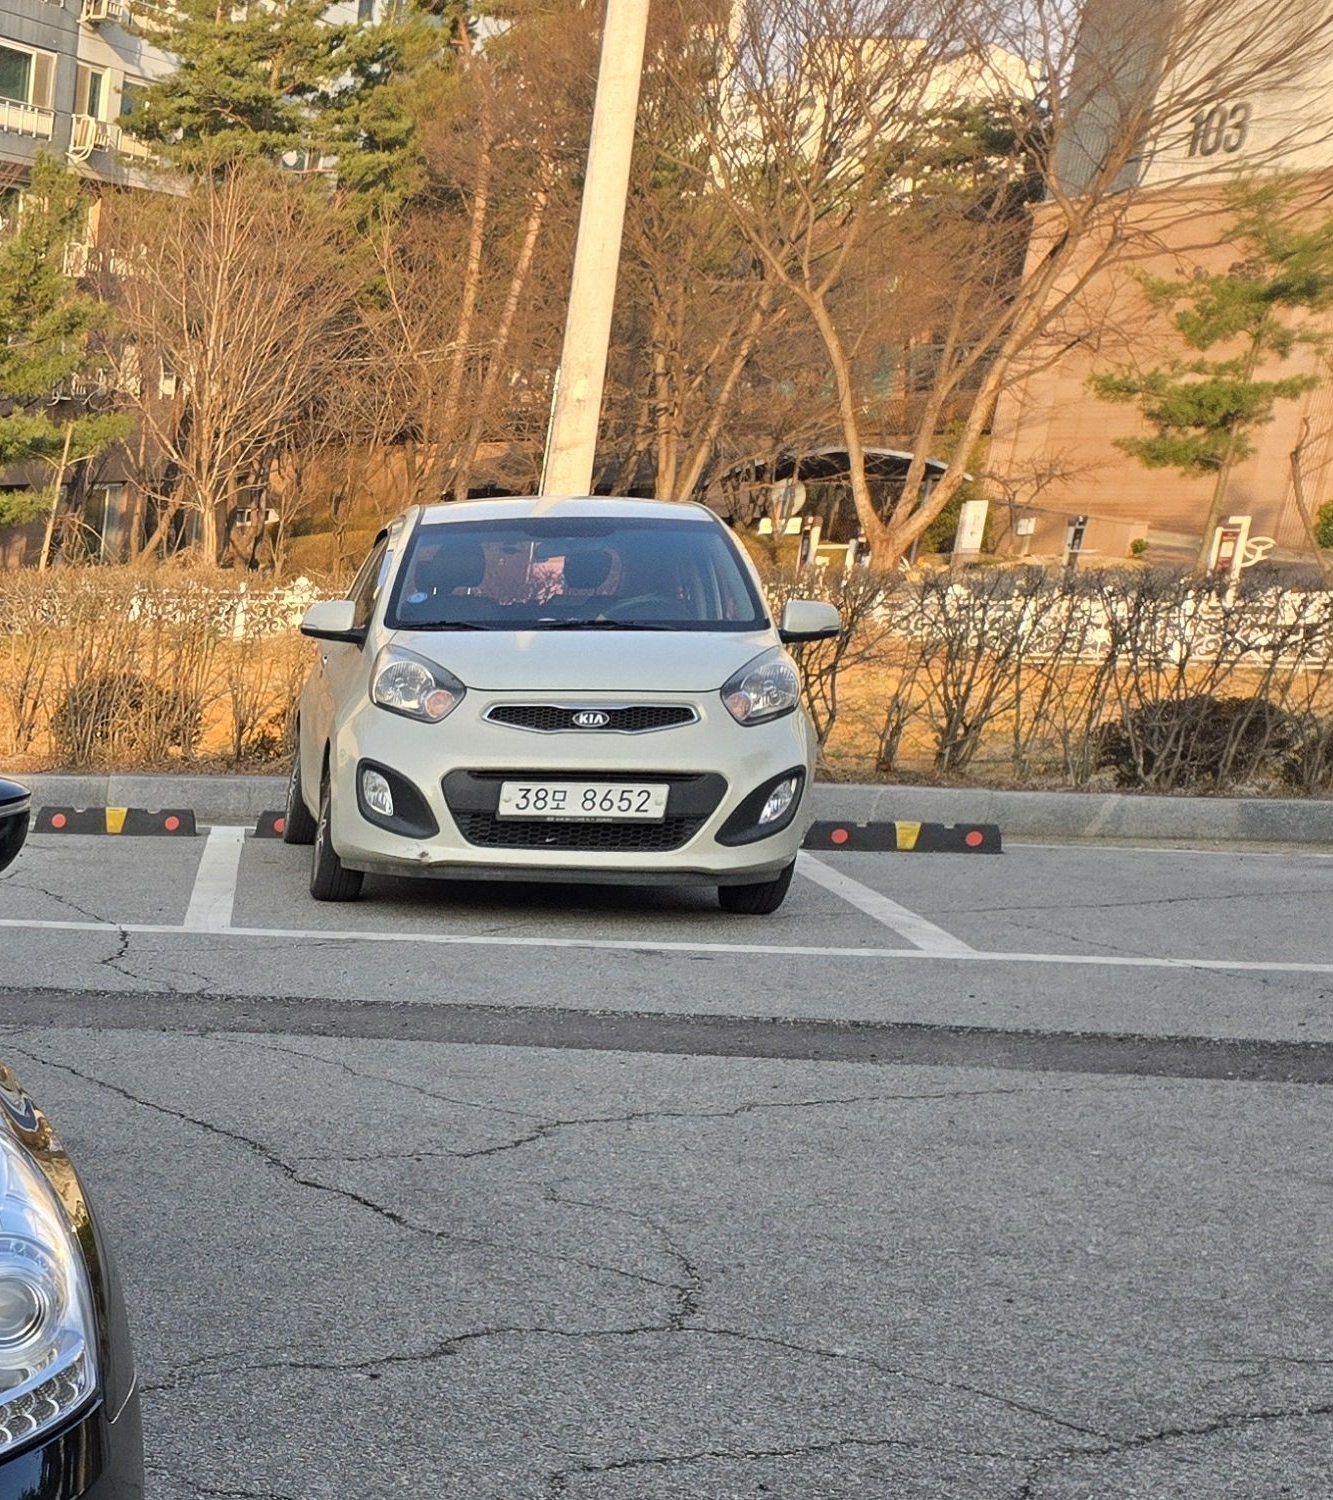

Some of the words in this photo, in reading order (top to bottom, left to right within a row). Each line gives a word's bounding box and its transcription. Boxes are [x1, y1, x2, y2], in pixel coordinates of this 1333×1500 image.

[1187, 101, 1253, 157] 103
[578, 713, 604, 725] KIA
[515, 788, 567, 811] 38모
[581, 788, 651, 813] 8652
